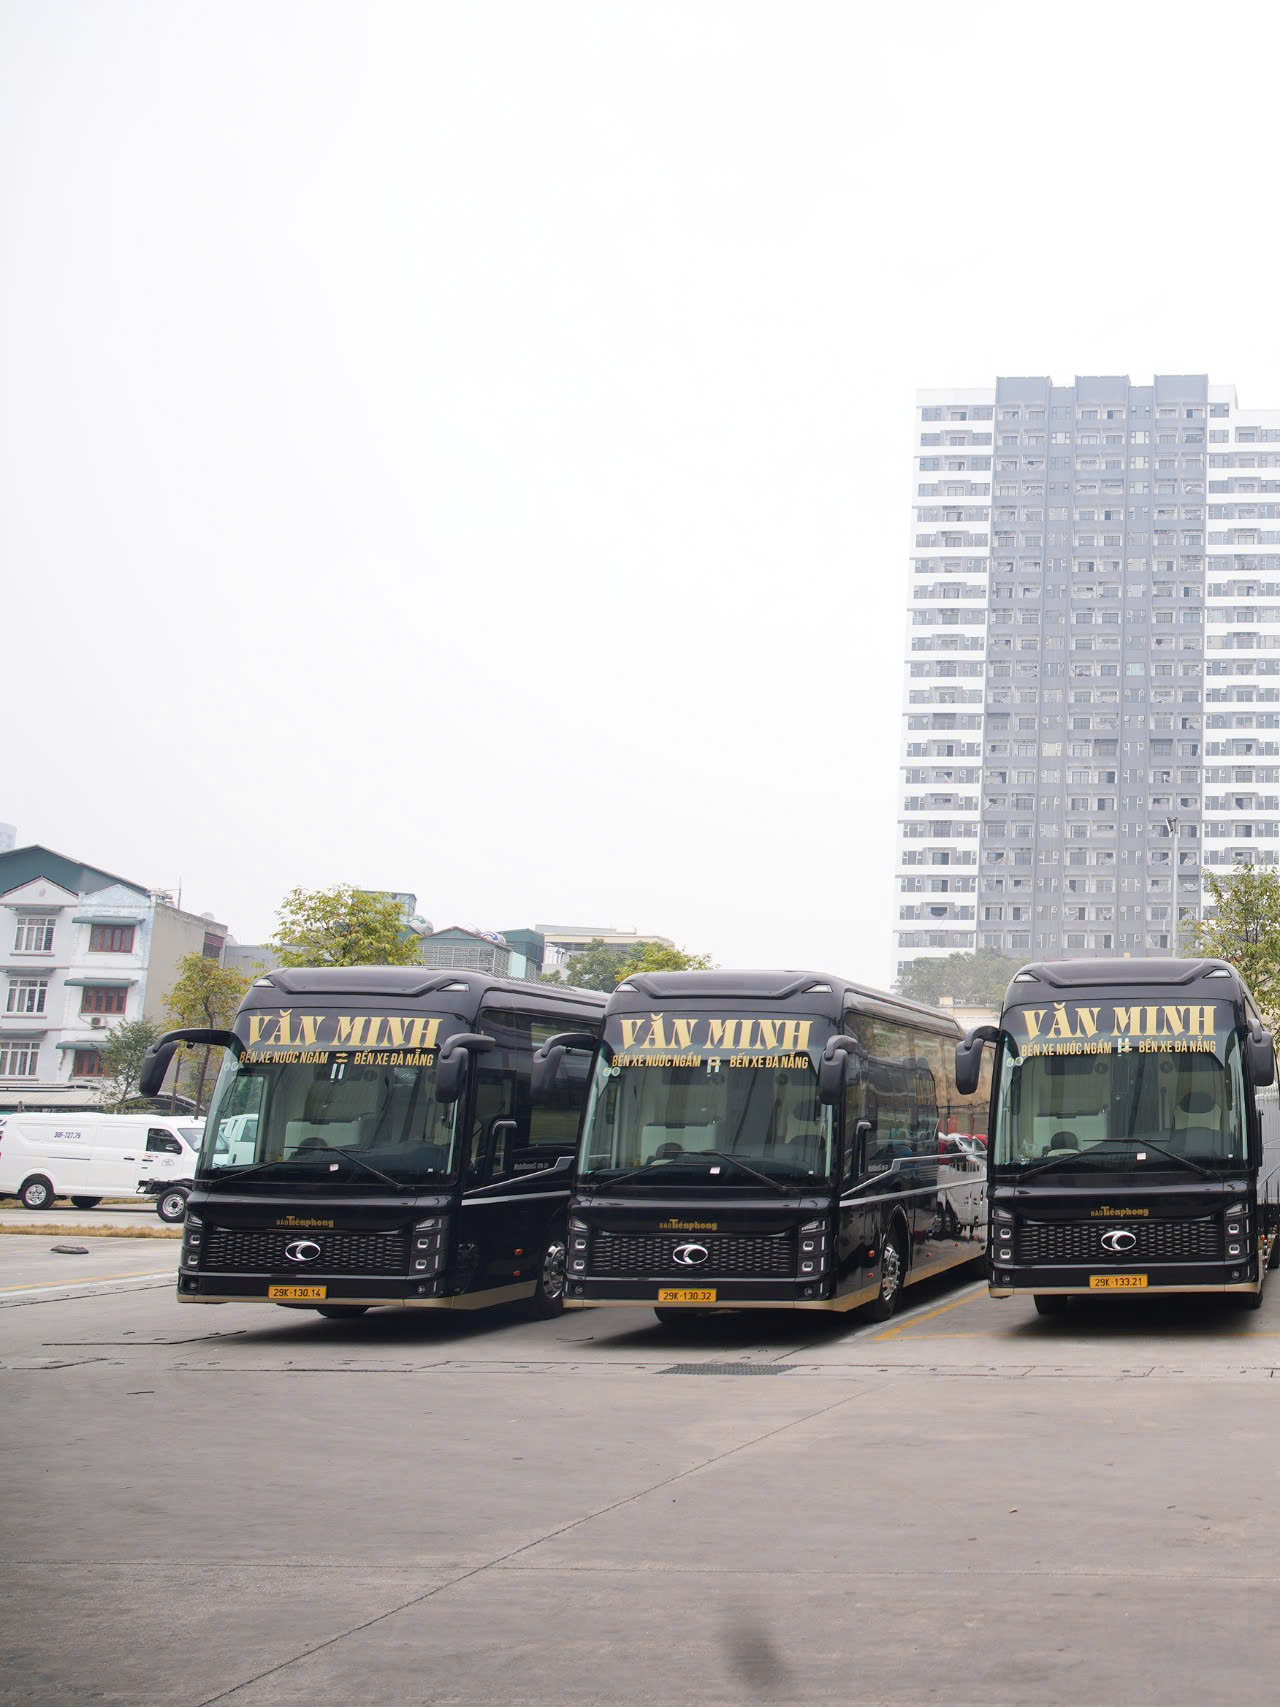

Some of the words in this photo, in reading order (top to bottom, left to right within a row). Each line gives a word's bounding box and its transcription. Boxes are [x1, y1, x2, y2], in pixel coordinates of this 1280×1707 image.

[1022, 1002, 1101, 1040] VĂN
[1111, 1005, 1217, 1036] MINH
[249, 1009, 325, 1047] VĂN
[330, 1016, 443, 1049] MINH
[620, 1013, 698, 1050] VĂN
[703, 1019, 813, 1050] MINH
[1042, 1043, 1054, 1056] XE
[1139, 1037, 1158, 1053] BẾN
[1160, 1040, 1172, 1053] XE
[1174, 1038, 1188, 1053] ĐÀ
[258, 1051, 272, 1063] XE
[354, 1049, 373, 1065] BẾN
[375, 1053, 389, 1065] XE
[390, 1050, 403, 1065] ĐÀ
[631, 1055, 643, 1067] XE
[730, 1052, 749, 1068] BẾN
[751, 1056, 765, 1068] XE
[766, 1053, 778, 1068] ĐÀ
[1095, 1278, 1142, 1287] 29K-133.21
[273, 1288, 321, 1297] 29K-130.14
[663, 1291, 712, 1300] 29K-130.32
